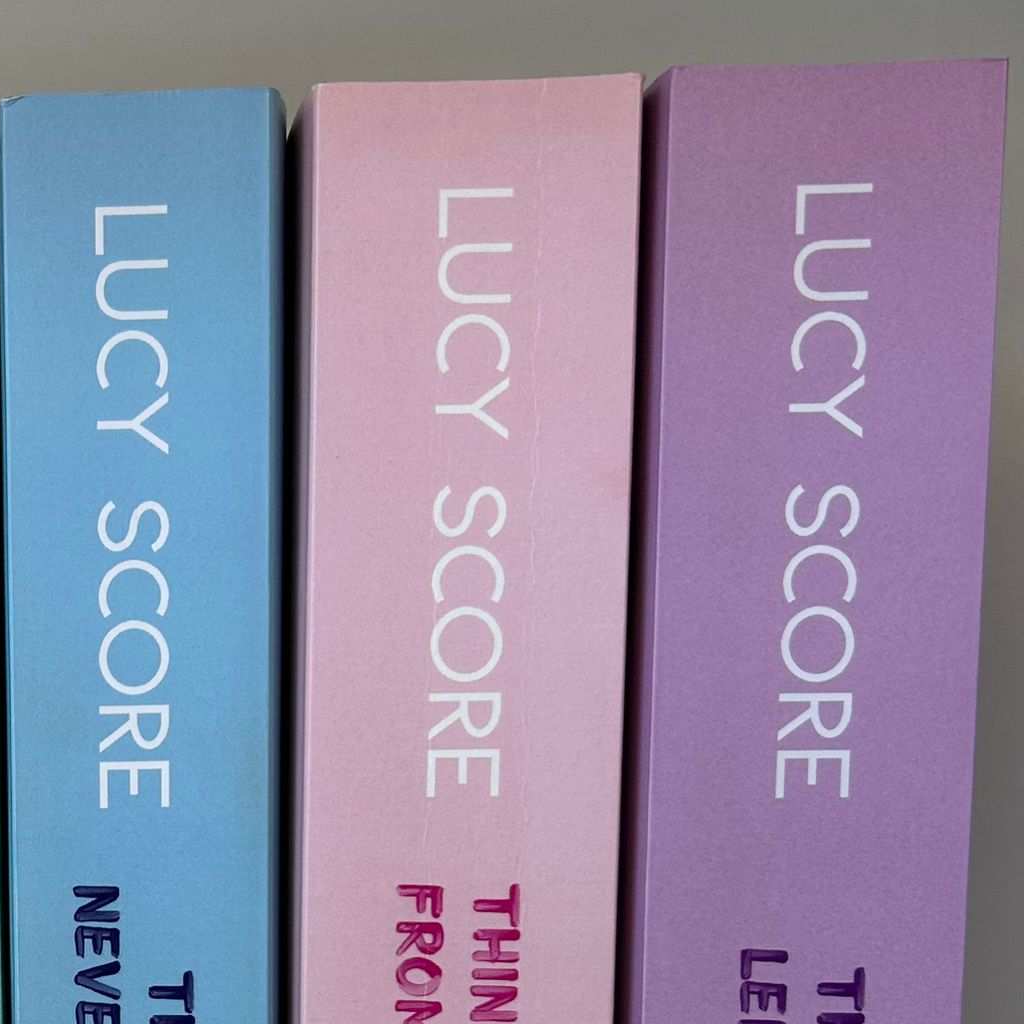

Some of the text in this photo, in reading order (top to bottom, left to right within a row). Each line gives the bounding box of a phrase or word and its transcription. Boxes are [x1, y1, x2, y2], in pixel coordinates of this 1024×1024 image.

[94, 204, 170, 809] LUCY SCORE
[426, 188, 514, 797] LUCY SCORE
[775, 182, 873, 799] LUCY SCORE
